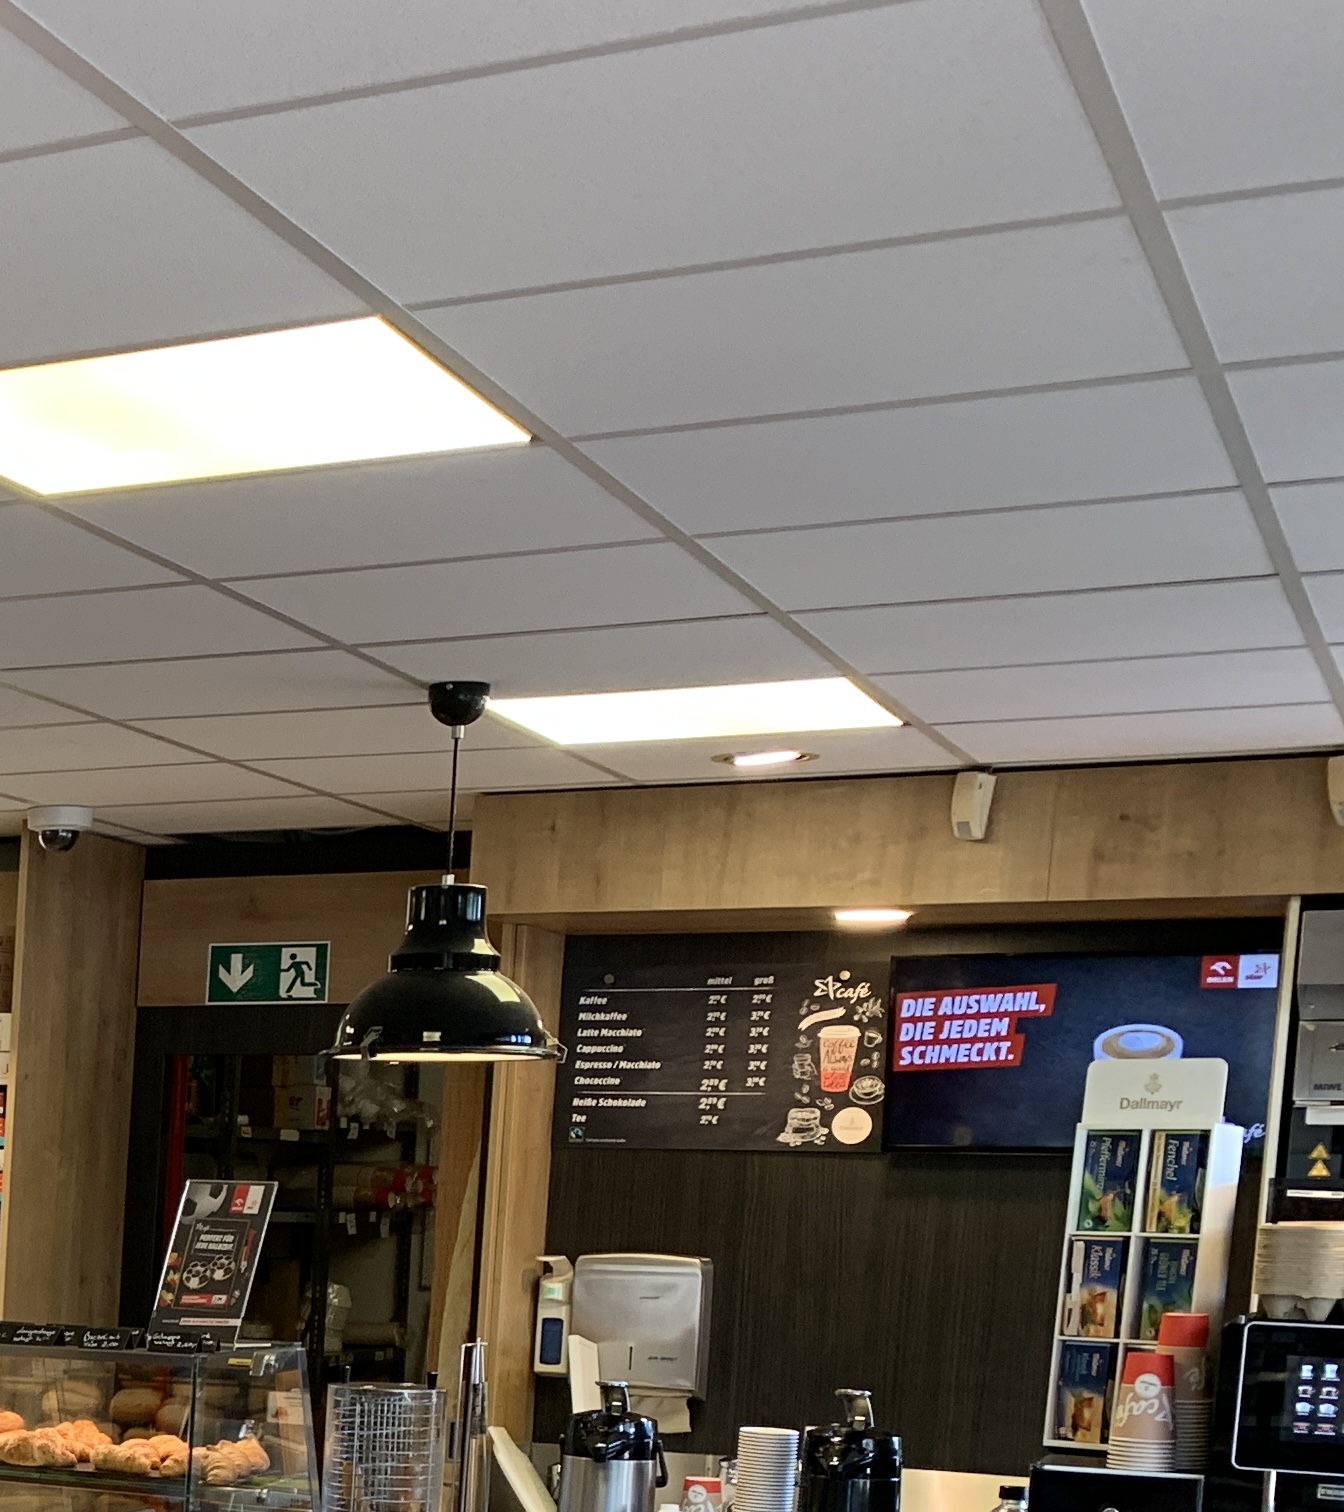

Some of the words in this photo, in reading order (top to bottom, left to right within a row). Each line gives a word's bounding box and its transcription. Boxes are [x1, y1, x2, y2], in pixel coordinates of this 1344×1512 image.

[707, 977, 733, 985] mittel
[579, 996, 607, 1005] Kaffee
[901, 997, 936, 1017] DIE
[939, 992, 1046, 1015] AUSWAHL,
[578, 1012, 627, 1021] Milchkaffee
[577, 1029, 598, 1037] Latte
[600, 1028, 642, 1037] Macchiato
[900, 1020, 936, 1040] DIE
[939, 1017, 1009, 1039] JEDEM
[576, 1045, 623, 1054] Cappuccino
[899, 1042, 1014, 1065] SCHMECKT.
[575, 1061, 612, 1069] Espresso
[619, 1061, 660, 1069] Macchiato
[574, 1077, 620, 1085] Chococcino
[598, 1098, 646, 1107] Schokolade
[1119, 1097, 1184, 1112] Dallmayr
[572, 1114, 587, 1122] Tee
[1166, 1139, 1180, 1181] Fenchel
[1089, 1245, 1102, 1279] Klassik
